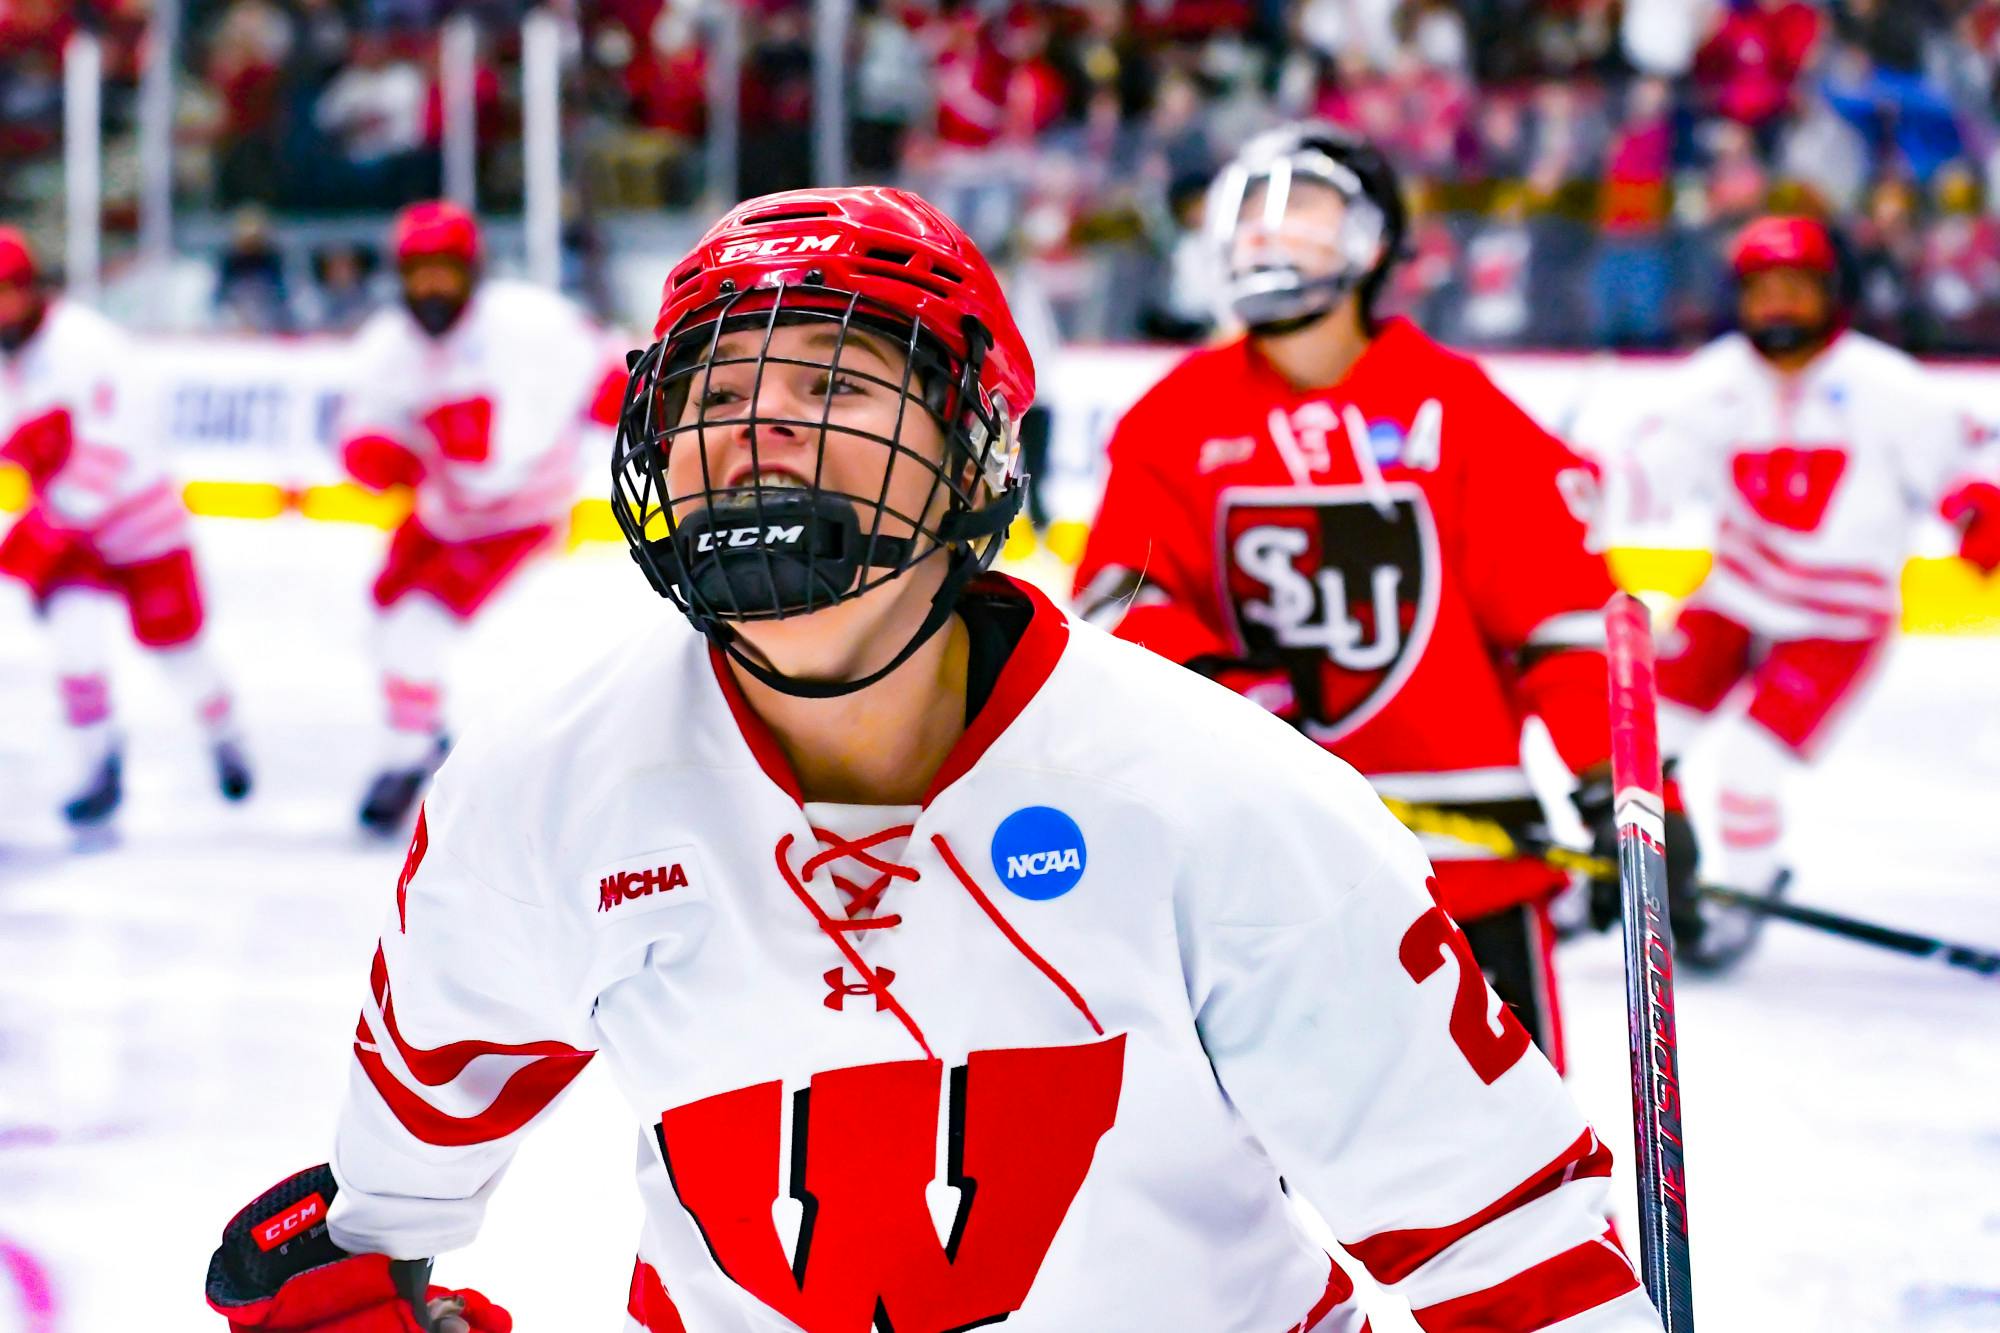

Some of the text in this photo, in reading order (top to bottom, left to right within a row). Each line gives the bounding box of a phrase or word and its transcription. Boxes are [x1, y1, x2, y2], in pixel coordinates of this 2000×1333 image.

[718, 234, 841, 264] CCM
[1402, 398, 1443, 472] A
[697, 525, 805, 553] CCM
[1234, 524, 1402, 670] SLU
[597, 863, 689, 913] WCHA
[1006, 847, 1081, 880] NCAA
[1399, 875, 1532, 1086] 2
[1644, 934, 1688, 1235] JETSPEED
[655, 1033, 1127, 1333] W
[265, 1202, 317, 1241] CCM
